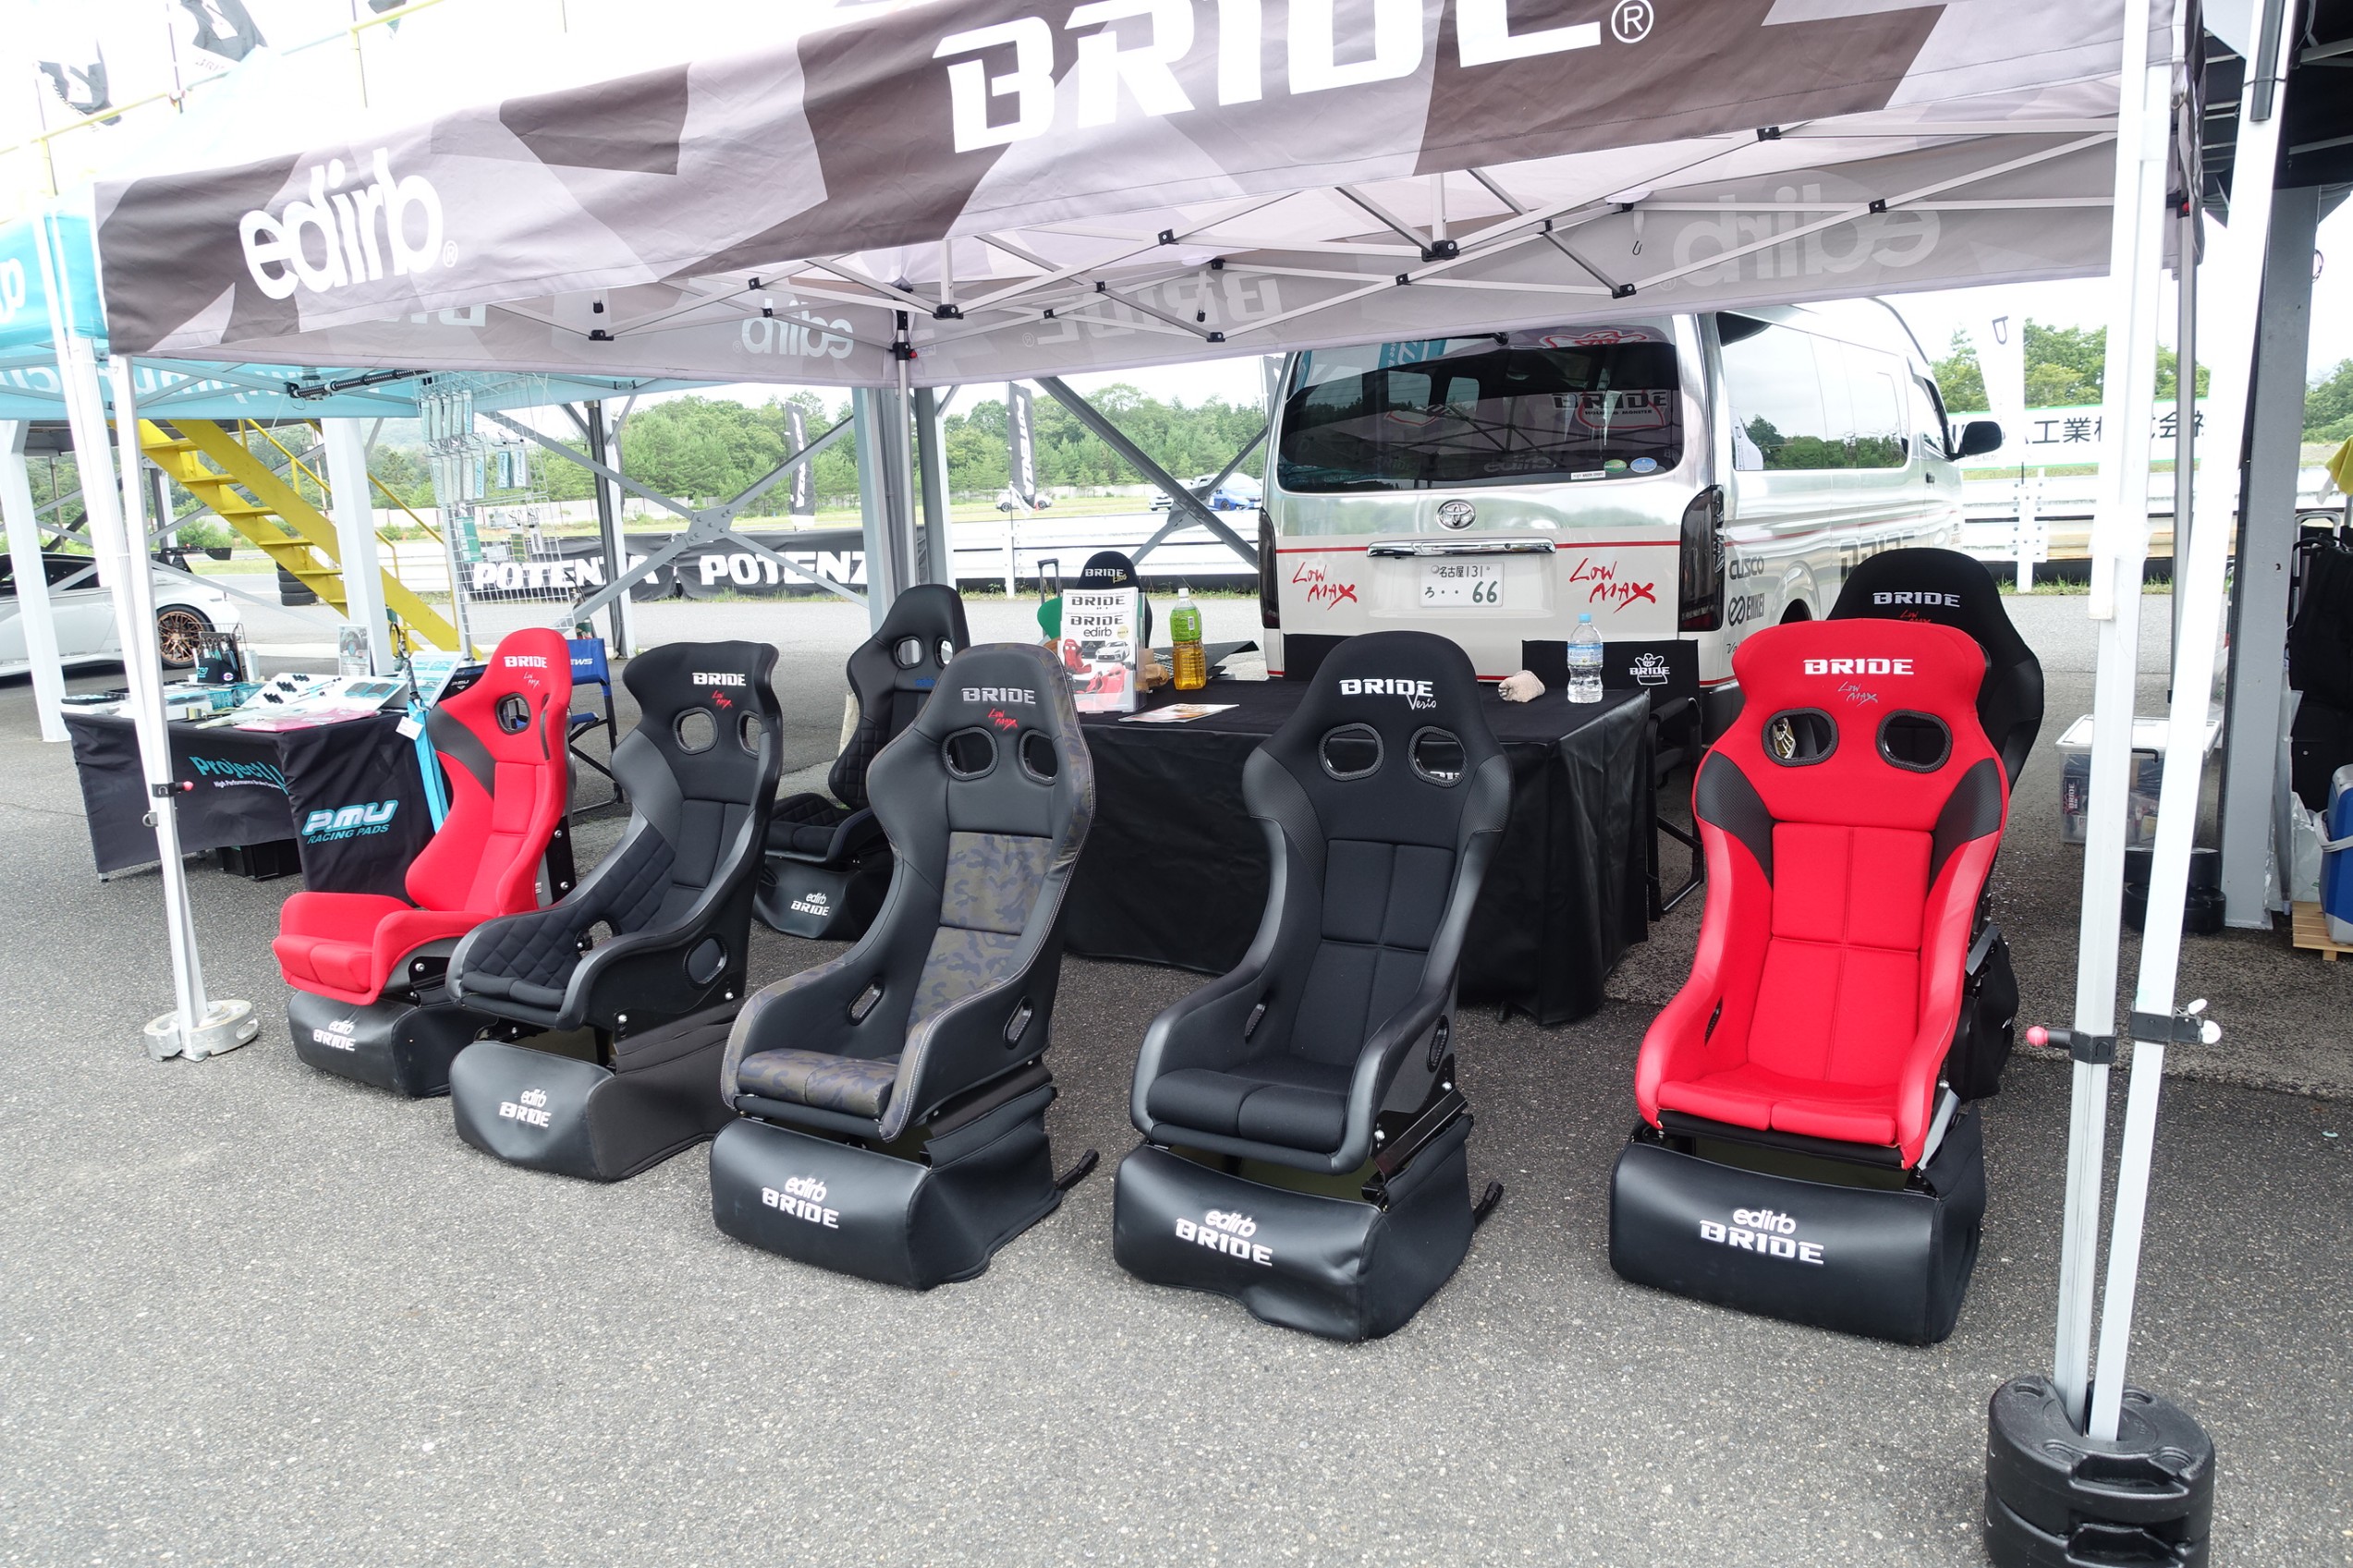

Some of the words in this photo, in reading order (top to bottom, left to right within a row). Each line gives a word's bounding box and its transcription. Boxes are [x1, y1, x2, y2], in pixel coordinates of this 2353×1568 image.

[239, 148, 442, 298] edirb
[1085, 568, 1125, 577] BRIDE
[1729, 555, 1764, 580] CUSCO
[1072, 595, 1126, 606] BRIDE
[1872, 592, 1960, 607] BRIDE
[1070, 614, 1124, 626] BRIDE
[1083, 626, 1113, 638] edirb
[504, 656, 547, 668] BRIDE
[1629, 666, 1671, 675] BRIDE
[1803, 658, 1915, 675] BRIDE
[691, 672, 747, 687] BRIDE
[1338, 678, 1434, 698] BRIDE
[961, 687, 1036, 704] BRIDE
[307, 830, 354, 845] RACING
[357, 824, 390, 837] PADS
[790, 900, 830, 917] BRIDE
[313, 1028, 357, 1051] BRIDE
[499, 1101, 552, 1128] BRIDE
[785, 1176, 827, 1202] edirb
[762, 1186, 839, 1230] BRIDE
[1205, 1210, 1257, 1237] edirb
[1732, 1209, 1797, 1235] edirb
[1176, 1217, 1274, 1267] BRIDE
[1699, 1219, 1824, 1265] BRIDE
